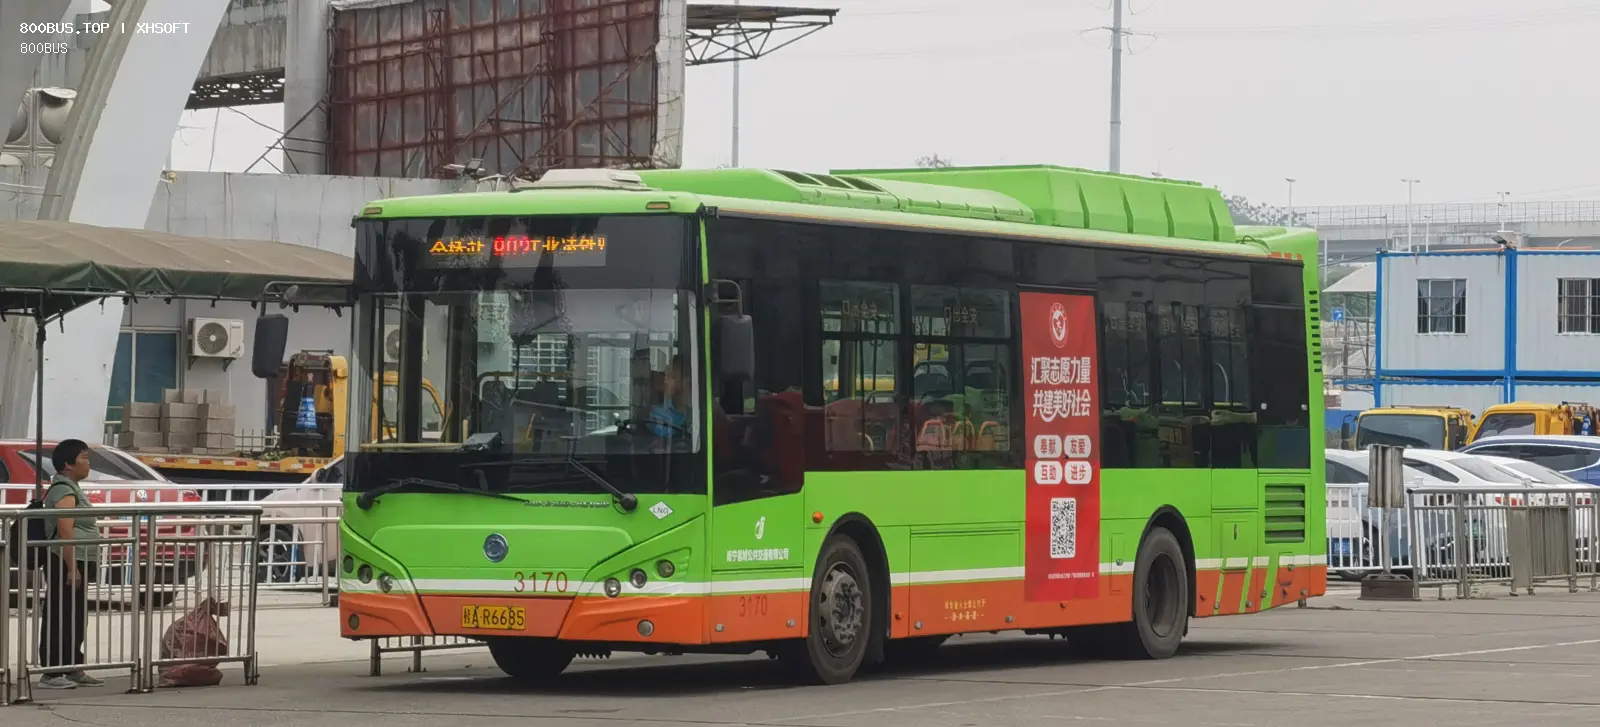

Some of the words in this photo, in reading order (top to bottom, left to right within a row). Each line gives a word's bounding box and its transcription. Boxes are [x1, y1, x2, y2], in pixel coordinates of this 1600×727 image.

[1030, 356, 1091, 385] 汇聚志愿力量
[1032, 388, 1092, 423] 共建美好社会
[1040, 438, 1057, 455] 奉献
[1070, 438, 1086, 454] 友爱
[1070, 464, 1087, 481] 进步
[652, 506, 669, 516] LNG
[513, 571, 569, 593] 3170
[739, 595, 768, 617] 3170
